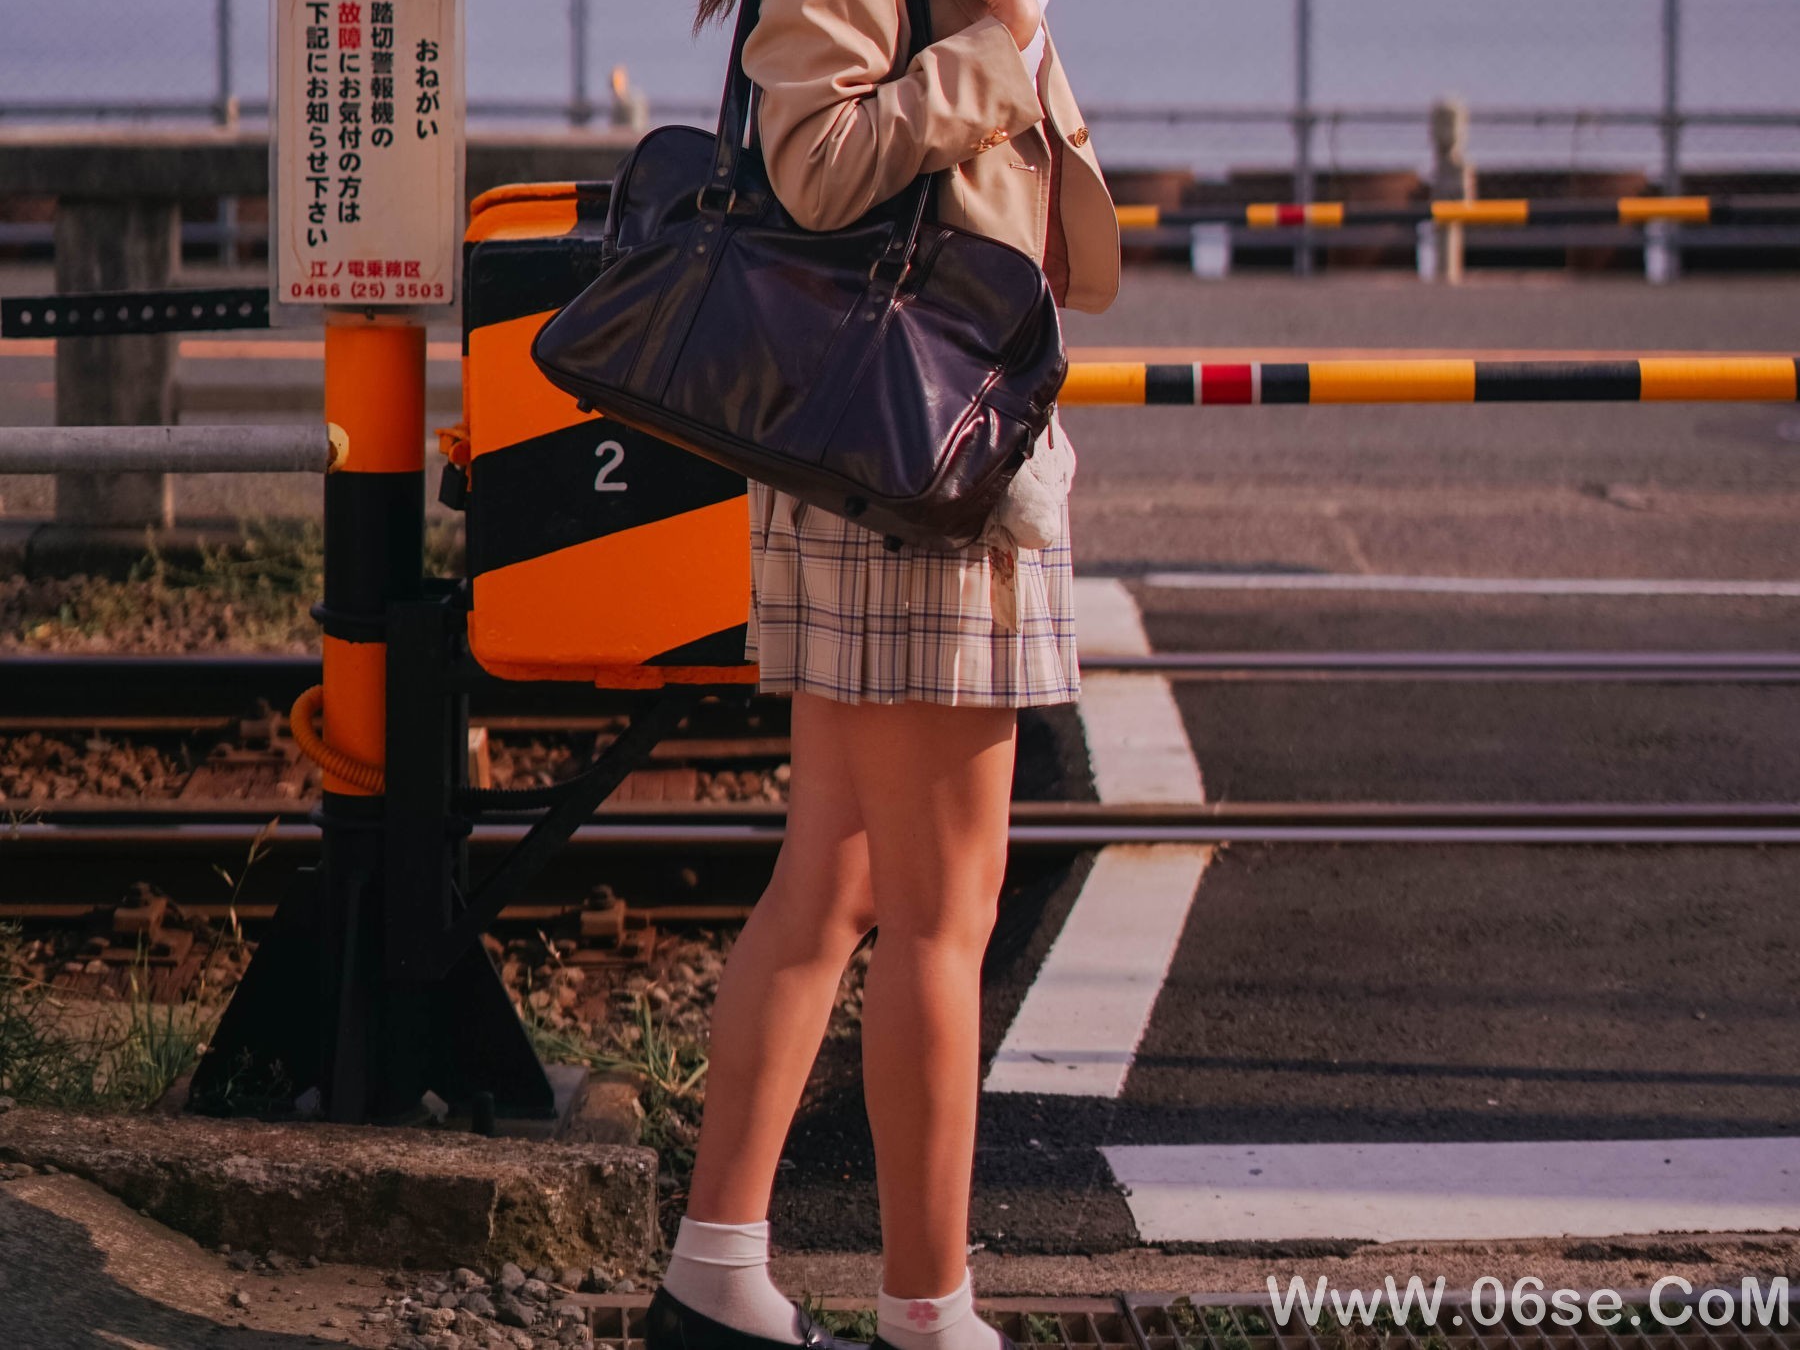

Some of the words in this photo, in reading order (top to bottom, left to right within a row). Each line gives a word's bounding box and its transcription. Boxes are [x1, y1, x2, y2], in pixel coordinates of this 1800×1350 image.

[306, 2, 329, 247] 下記にお知らせ下さい
[338, 2, 361, 223] 故障にお気付の方は
[370, 2, 394, 148] 踏切警報機の
[416, 38, 440, 139] おねがい
[594, 440, 628, 491] 2
